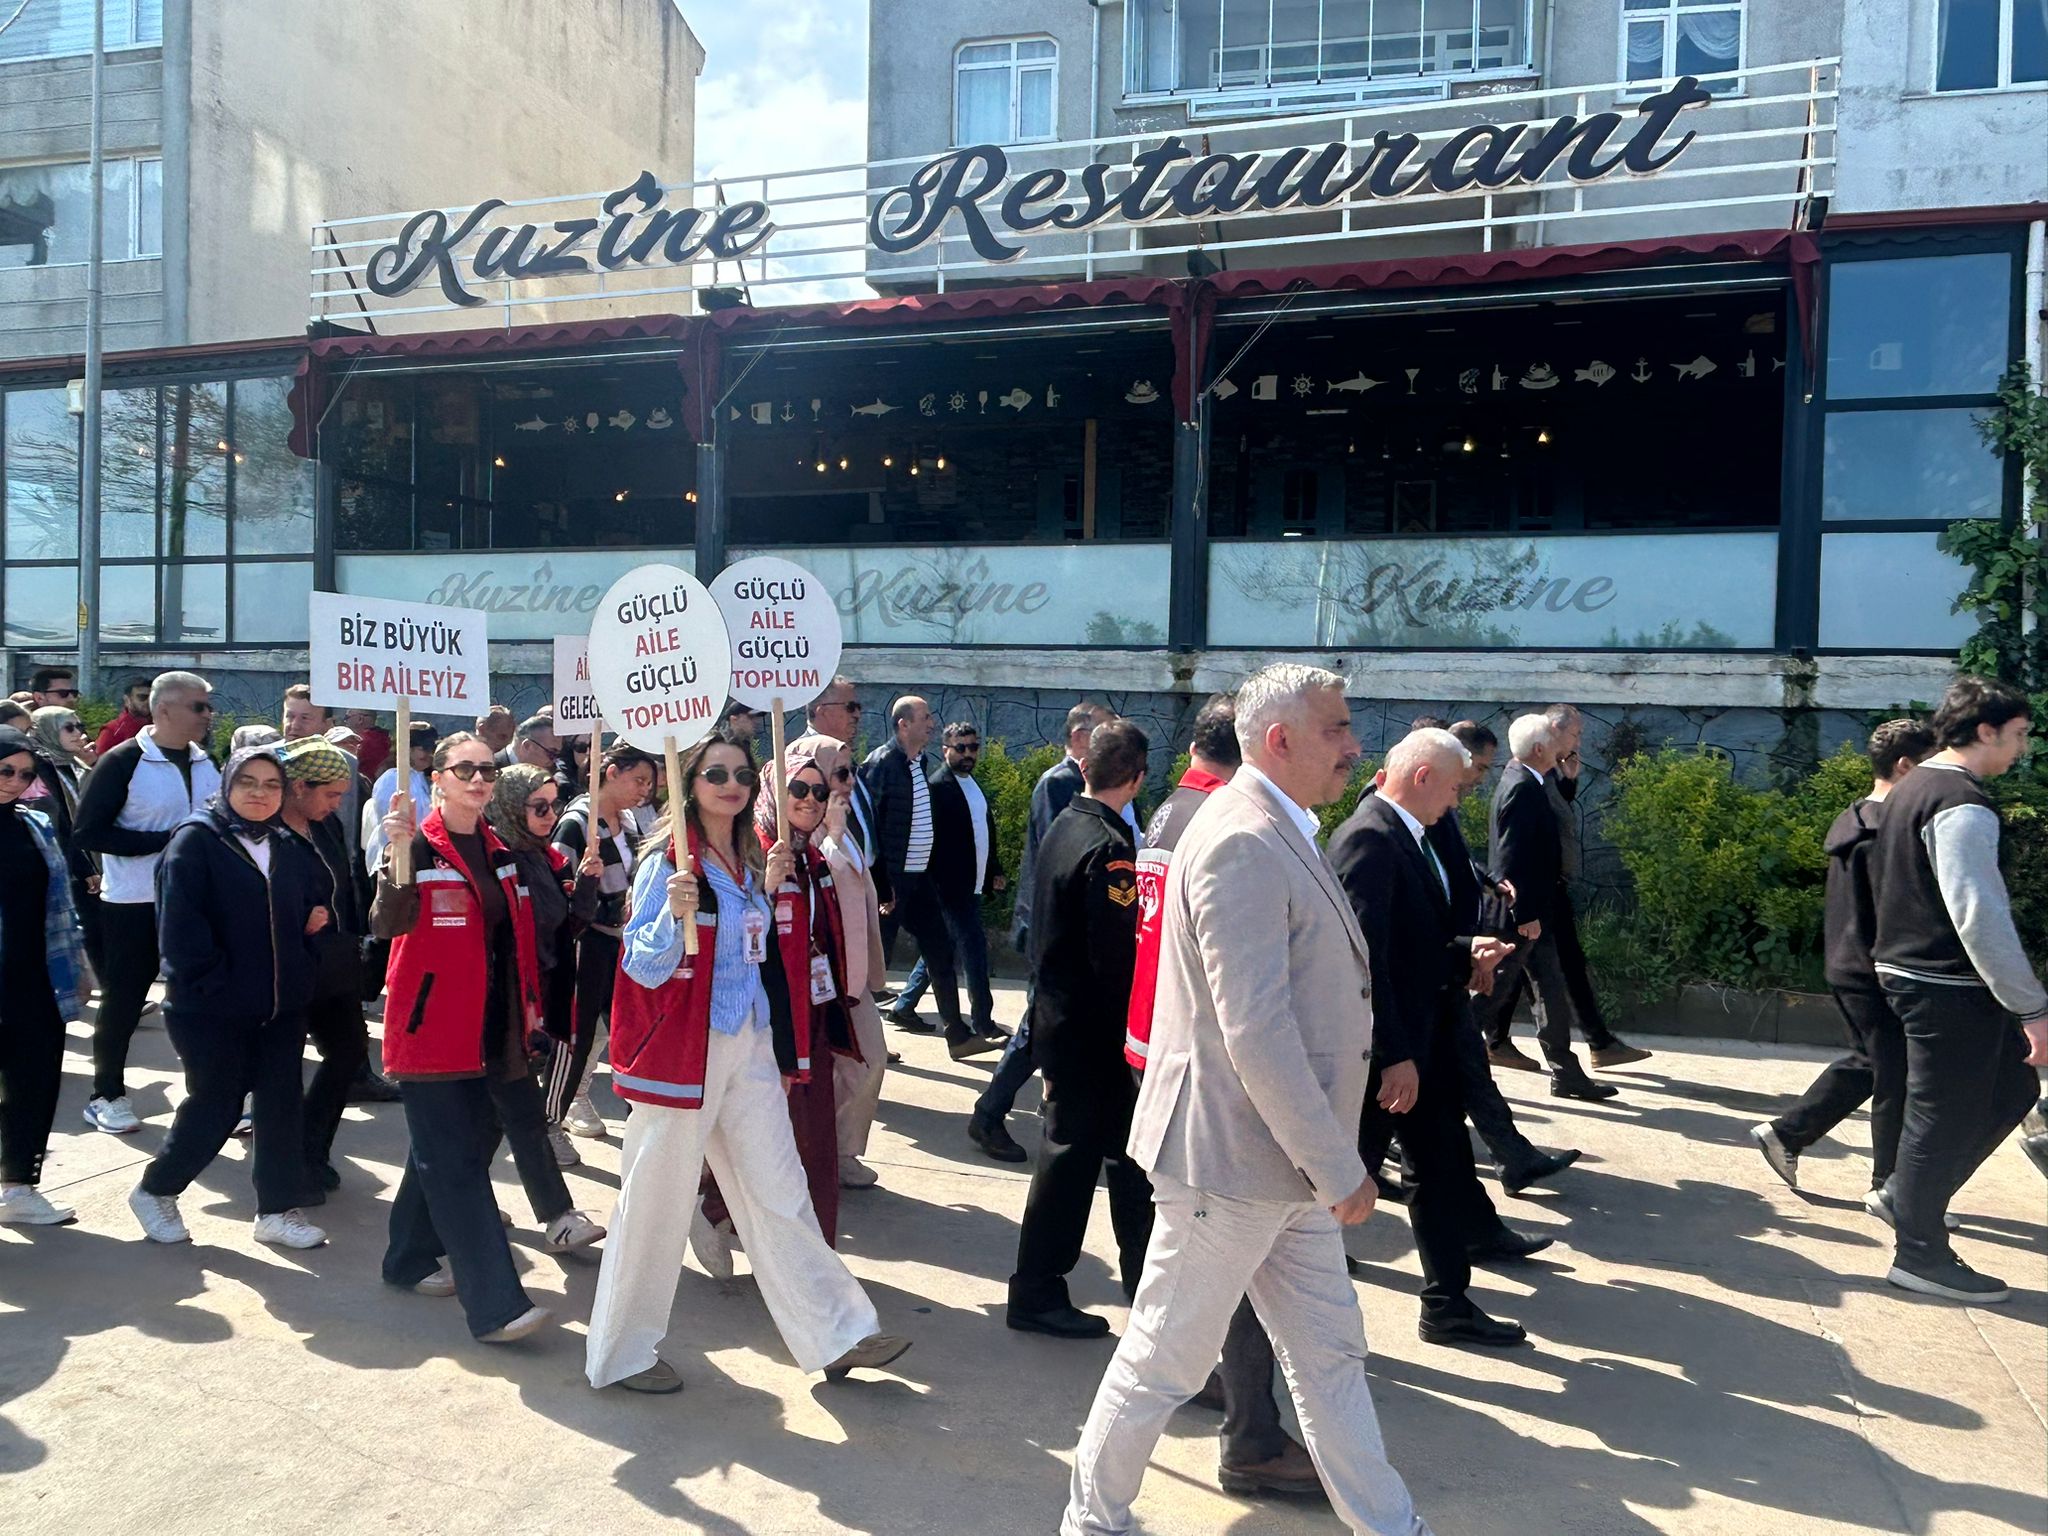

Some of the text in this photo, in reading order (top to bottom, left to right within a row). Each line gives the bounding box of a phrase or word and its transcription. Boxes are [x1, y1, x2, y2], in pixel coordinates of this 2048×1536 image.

[869, 76, 1711, 264] Restaurant
[617, 585, 688, 624] GÜÇLÜ
[734, 577, 806, 605] GÜÇLÜ
[340, 612, 463, 656] BİZ BÜYÜK
[750, 607, 796, 629] AİLE
[635, 627, 681, 657] AİLE
[738, 636, 810, 663] GÜÇLÜ
[337, 657, 468, 700] BİR AİLEYİZ
[626, 655, 698, 695] GÜÇLÜ
[731, 669, 820, 688] TOPLUM
[621, 695, 713, 730] TOPLUM
